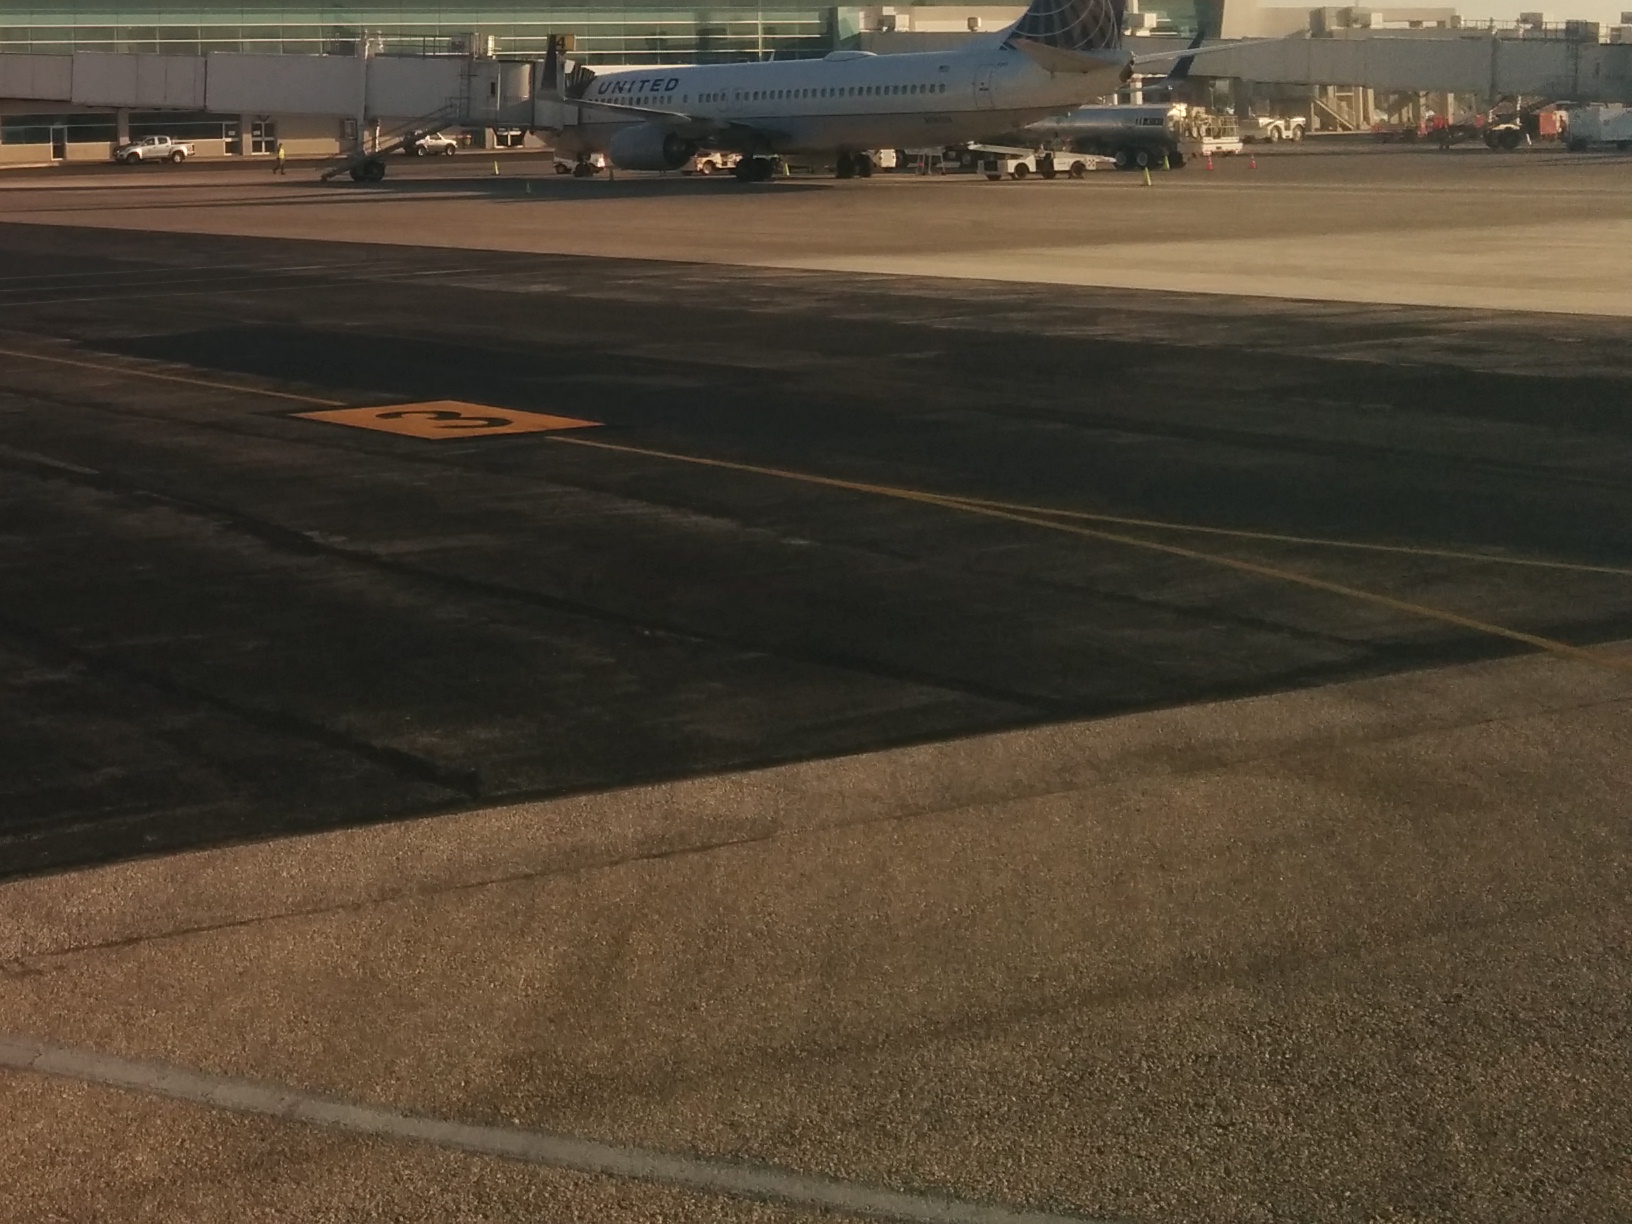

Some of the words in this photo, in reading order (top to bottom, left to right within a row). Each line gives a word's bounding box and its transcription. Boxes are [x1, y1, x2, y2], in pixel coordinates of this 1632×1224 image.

[556, 36, 566, 49] 4
[598, 78, 680, 95] UNITED
[375, 410, 514, 429] 3
